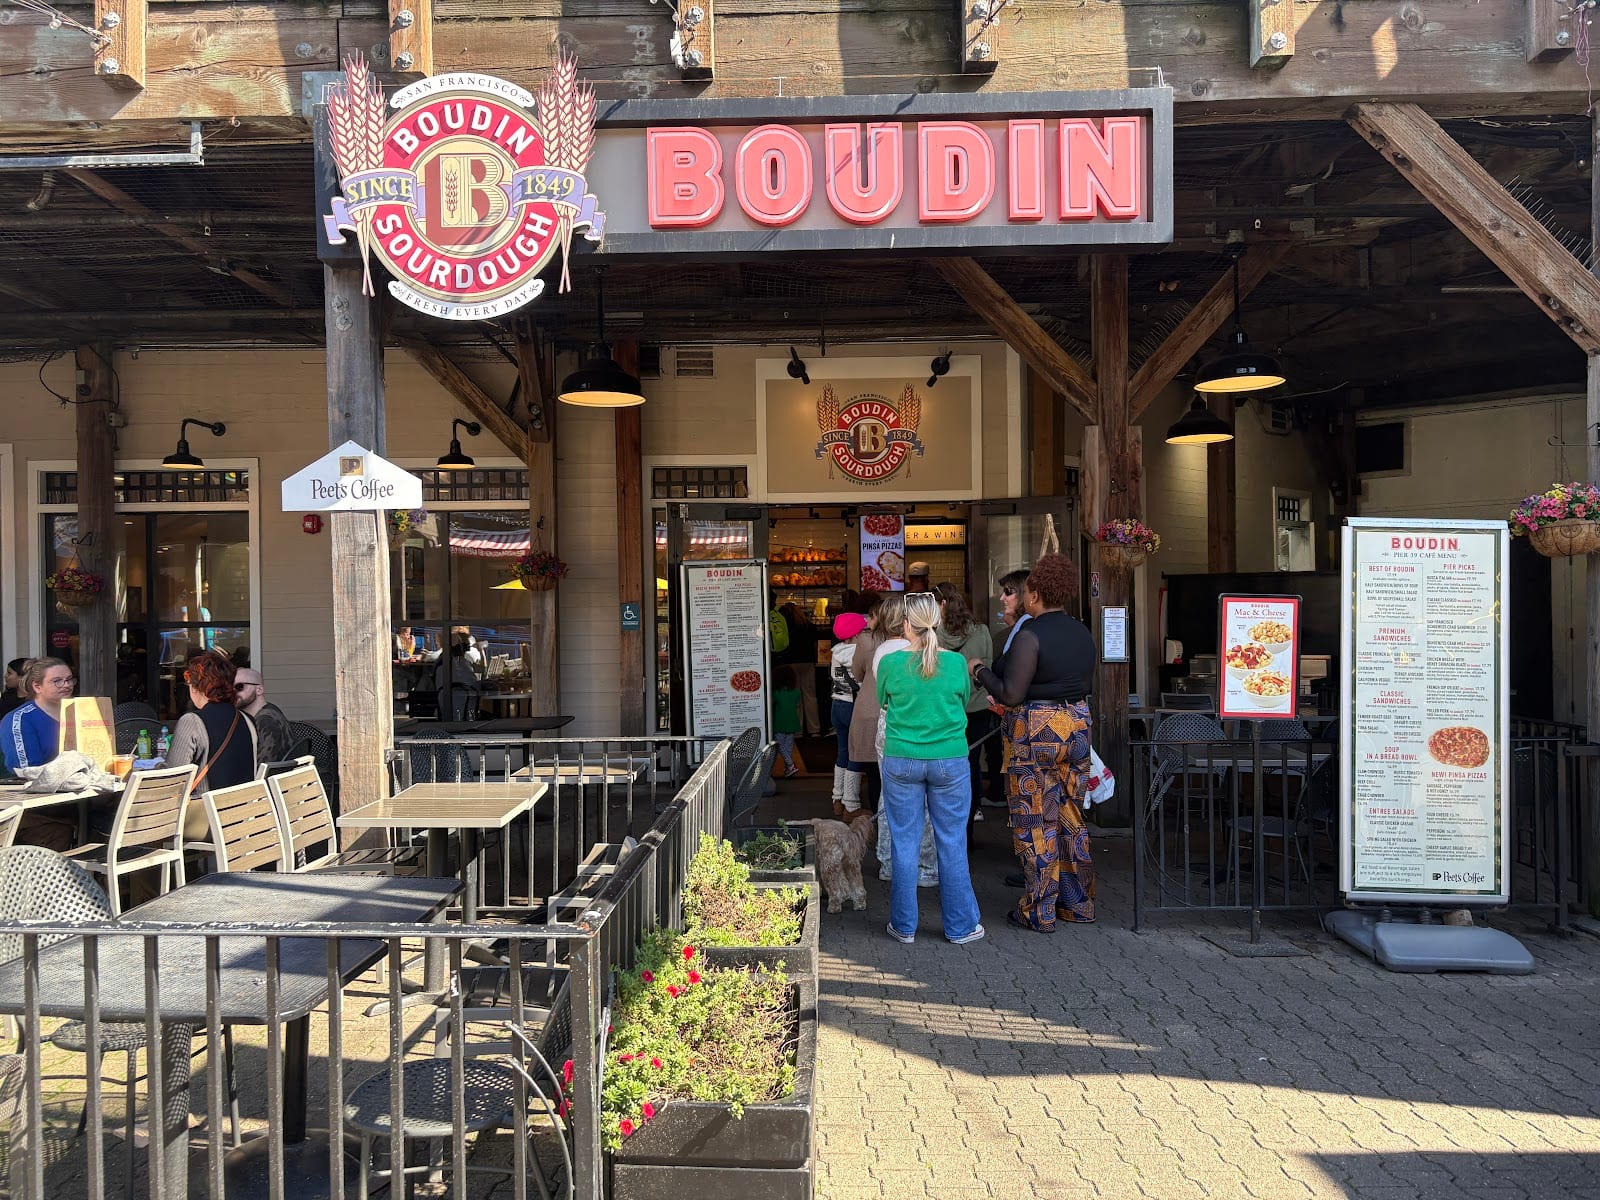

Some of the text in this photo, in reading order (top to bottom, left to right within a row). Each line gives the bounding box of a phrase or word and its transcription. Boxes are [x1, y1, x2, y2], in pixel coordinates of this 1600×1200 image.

[406, 76, 518, 98] SAN FRANCISCO
[392, 104, 535, 157] BOUDIN
[647, 117, 1140, 229] BOUDIN
[346, 176, 413, 203] SINCE
[524, 174, 575, 196] 1849
[376, 212, 553, 289] SOURDOUGH
[406, 290, 531, 317] FRESH EVERY DAY
[842, 404, 898, 424] BOUDIN
[824, 432, 850, 443] SINCE
[892, 432, 912, 440] 1849
[834, 446, 904, 476] SOURDOUGH
[310, 479, 394, 500] Peet's Coffee
[862, 542, 902, 550] PINSA PIZZAS
[1391, 538, 1458, 550] BOUDIN
[707, 570, 742, 578] BOUDIN
[1462, 871, 1485, 884] Coffee
